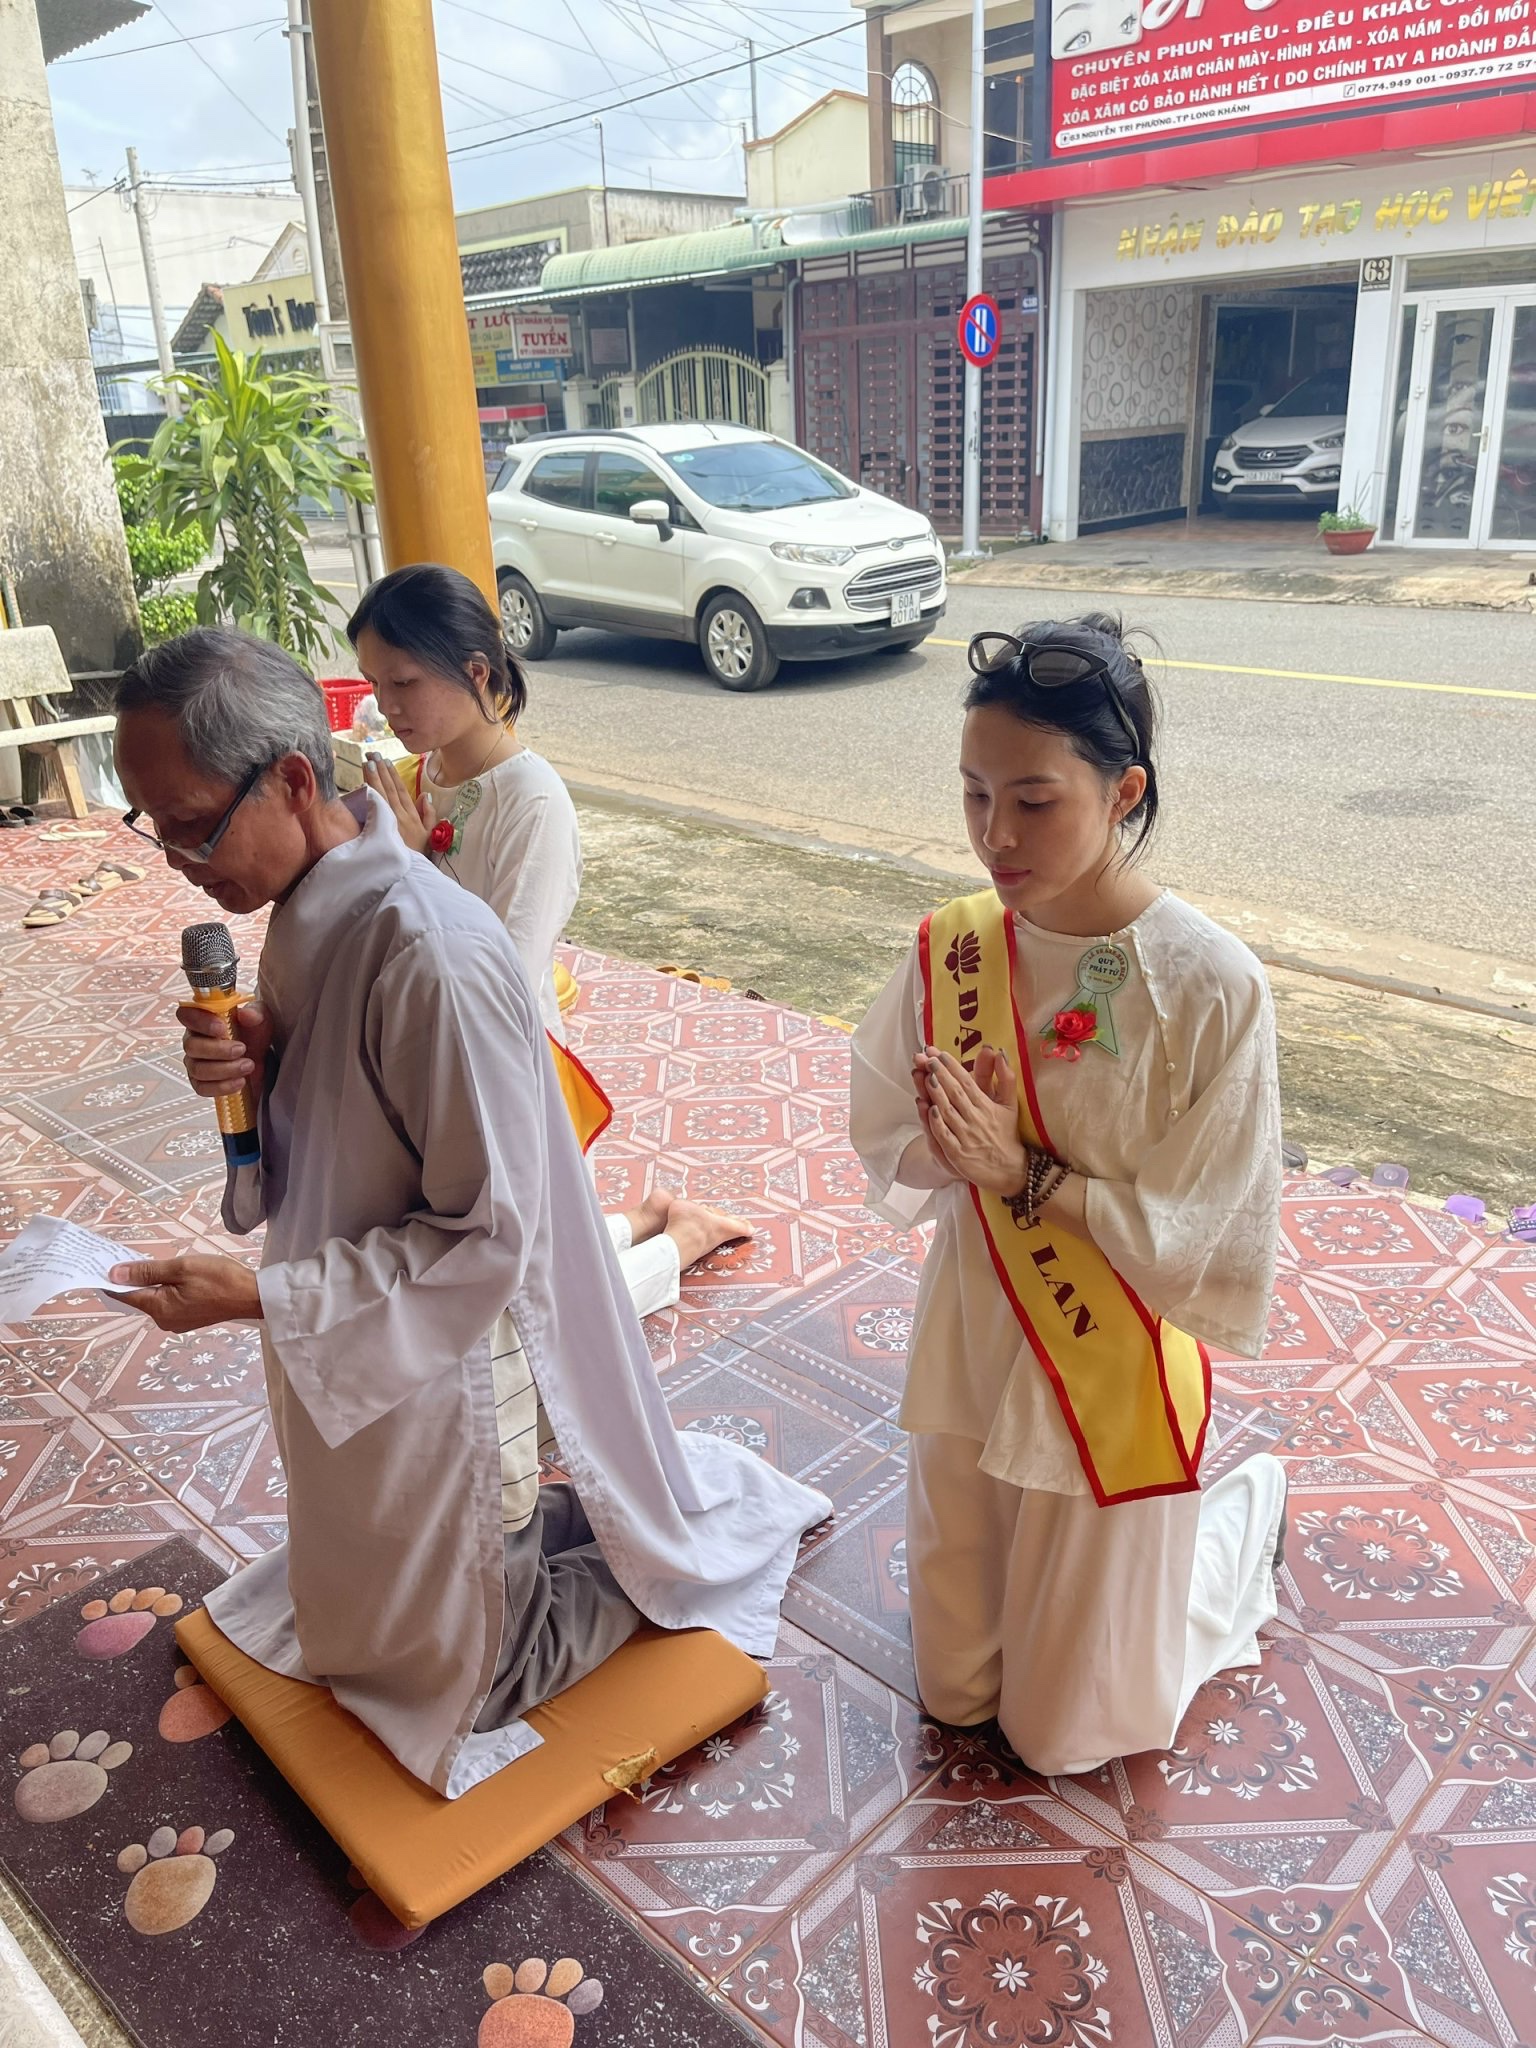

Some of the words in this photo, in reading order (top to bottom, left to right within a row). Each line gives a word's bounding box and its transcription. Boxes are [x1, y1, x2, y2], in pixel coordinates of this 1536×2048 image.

[1071, 49, 1150, 77] CHUYÊN
[1156, 37, 1213, 60] PHUN
[1296, 10, 1354, 34] ĐIÊU
[1071, 84, 1097, 102] ĐẶC
[1100, 76, 1129, 96] BIỆT
[1133, 71, 1159, 89] XÓA
[1196, 56, 1234, 77] CHÂN
[1317, 35, 1352, 55] XĂM
[1367, 26, 1400, 47] XÓA
[1404, 18, 1442, 39] NÁM
[1062, 107, 1090, 125] XÓA
[1129, 95, 1149, 113] CÓ
[1153, 89, 1185, 109] BẢO
[1189, 83, 1232, 103] HÀNH
[1237, 73, 1269, 94] HẾT
[1285, 70, 1308, 86] DO
[1313, 58, 1367, 81] CHÍNH
[1372, 53, 1408, 71] TAY
[1412, 50, 1425, 65] A
[1431, 37, 1497, 62] HOÀNH
[1217, 104, 1251, 117] KHÁNH
[1358, 78, 1412, 94] 0774.949
[1116, 212, 1205, 264] NHẬN
[1216, 207, 1284, 248] ĐÀO
[1298, 199, 1362, 247] TẠO
[1374, 187, 1454, 238] HỌC
[1364, 259, 1391, 282] 63
[1030, 1242, 1099, 1339] LAN
